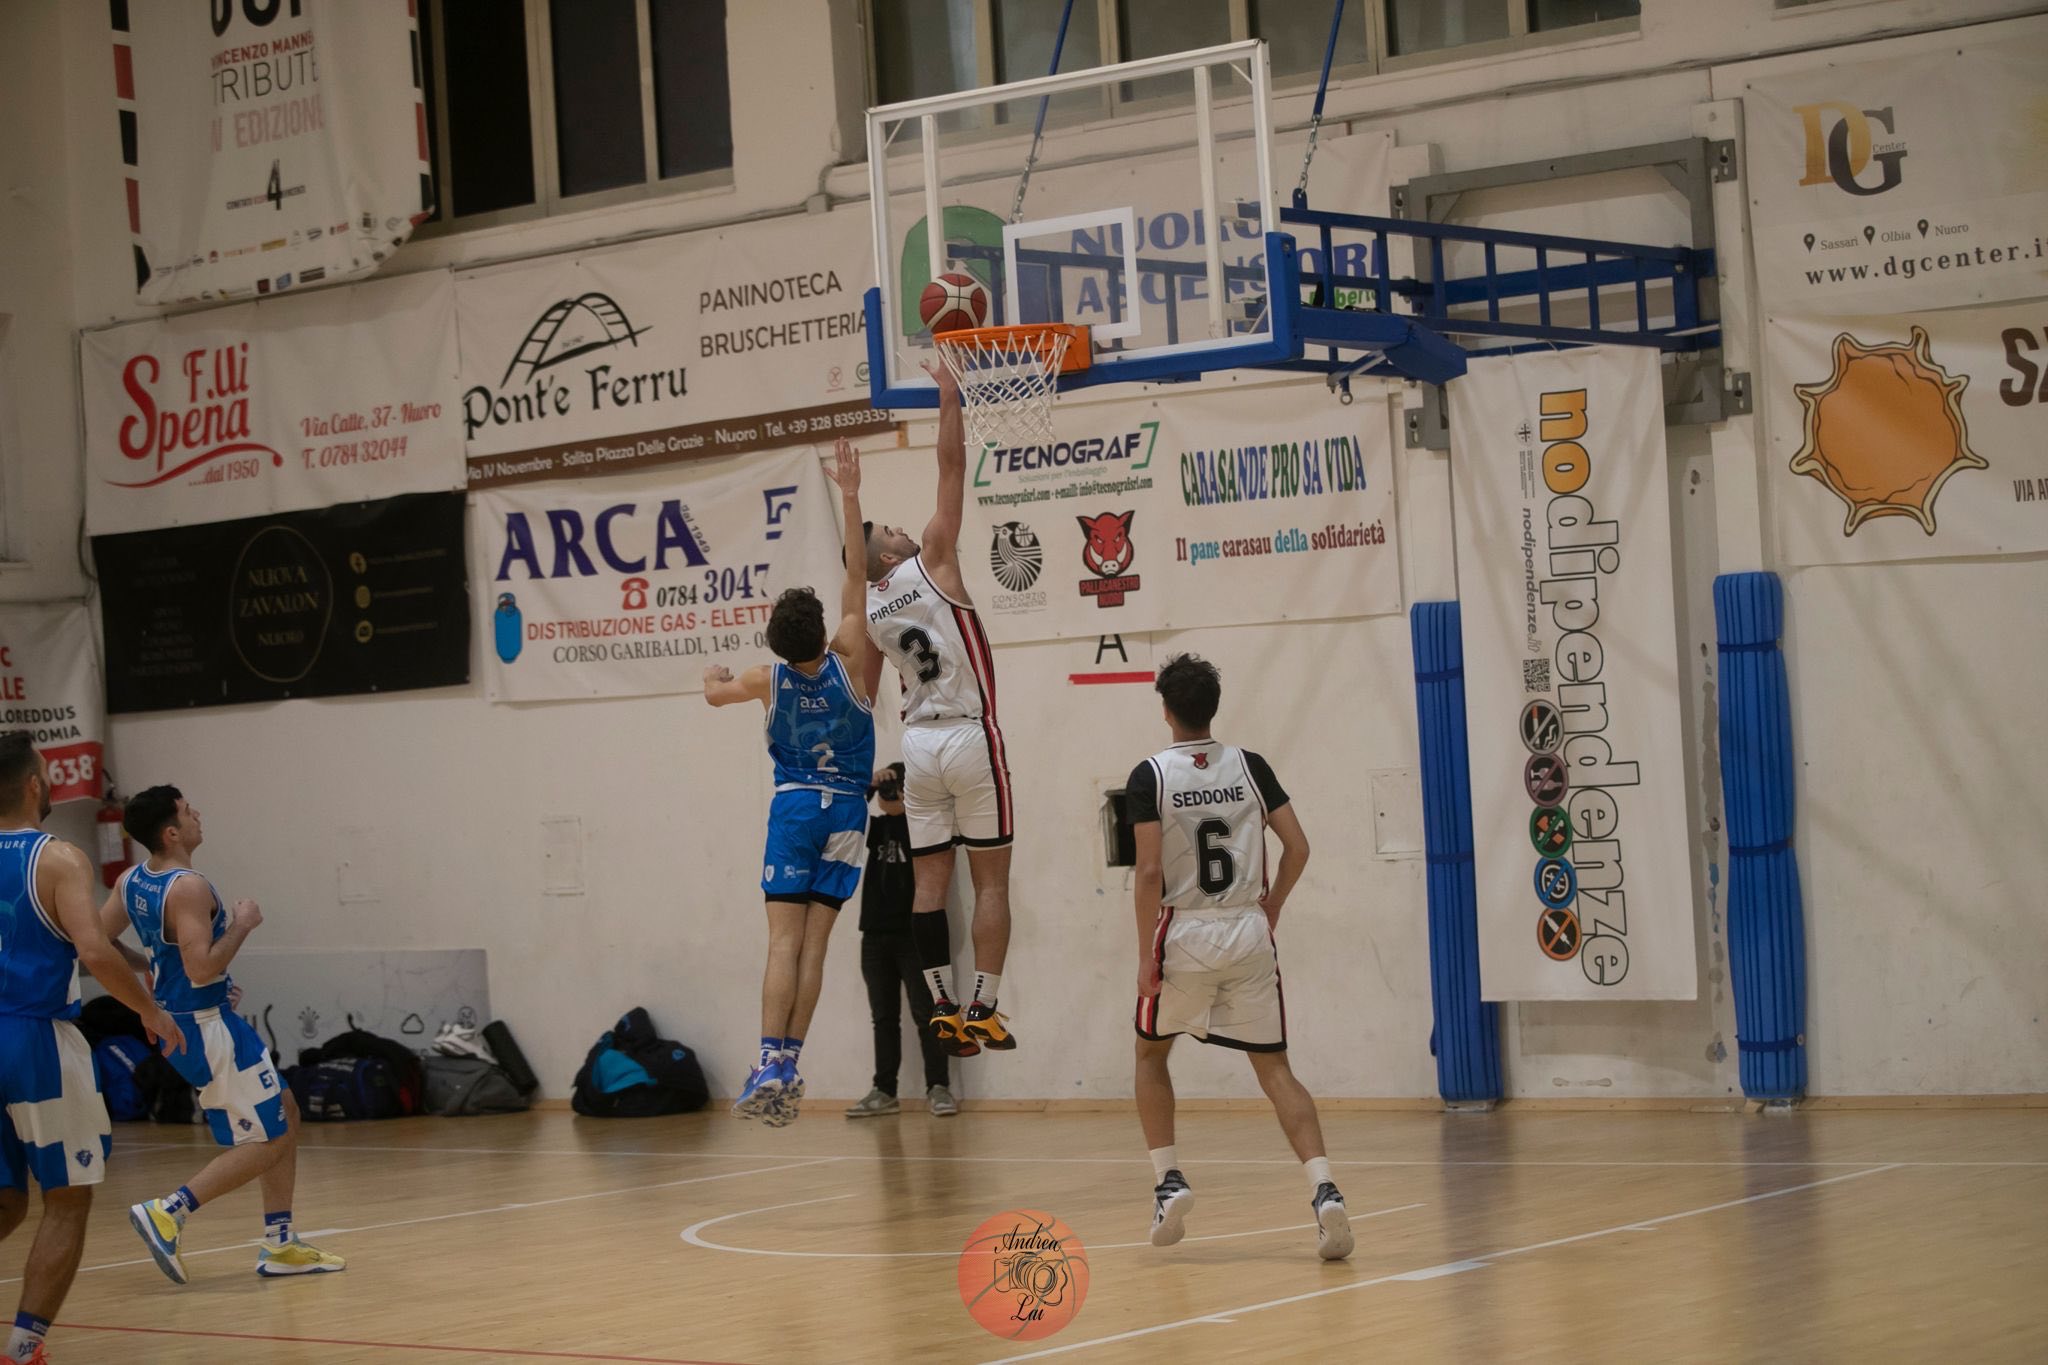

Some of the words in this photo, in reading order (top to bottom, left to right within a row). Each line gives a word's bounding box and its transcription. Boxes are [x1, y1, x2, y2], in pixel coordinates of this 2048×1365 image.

[1872, 140, 1907, 154] Center
[1820, 236, 1859, 250] Sassari
[1881, 230, 1911, 243] Olbia
[1934, 223, 1969, 237] Nuoro
[1805, 238, 2048, 285] www.dgcenter.i
[700, 270, 842, 315] PANINOTECA
[119, 355, 250, 472] Spena
[400, 402, 441, 424] Nuoro
[462, 375, 571, 440] Pont'e
[585, 364, 688, 411] Ferru
[302, 448, 315, 469] T.
[319, 440, 358, 468] 0784
[361, 436, 408, 462] 32044
[484, 463, 495, 478] IV
[497, 457, 553, 476] Novembre
[562, 451, 593, 467] Salita
[596, 447, 635, 463] Piazza
[637, 439, 666, 456] Delle
[667, 433, 704, 452] Grazie
[715, 427, 757, 445] Nuoro
[764, 421, 786, 437] Tel.
[788, 419, 808, 434] +39
[810, 415, 832, 431] 328
[993, 433, 1141, 473] TECNOGRAF
[227, 459, 260, 482] 1950
[1181, 446, 1268, 507] CARASANDE
[1271, 442, 1299, 498] PRO
[1303, 440, 1323, 496] SA
[1325, 435, 1366, 493] VIDA
[2013, 479, 2035, 501] VIA
[495, 499, 711, 581] ARCA
[1176, 537, 1188, 561] Il
[1190, 540, 1220, 566] pane
[1222, 537, 1272, 558] carasau
[1275, 527, 1309, 554] della
[1311, 519, 1386, 550] solidarietà
[657, 584, 698, 608] 0784
[868, 588, 922, 625] PIREDDA
[527, 616, 654, 641] DISTRIBUZIONE
[661, 612, 696, 633] GAS
[711, 604, 774, 627] ELETT
[553, 643, 607, 664] CORSO
[611, 637, 708, 661] GARIBALDI,
[713, 633, 740, 655] 149
[899, 626, 943, 684] 3
[1540, 388, 1642, 986] nodipendenze
[1172, 786, 1245, 809] SEDDONE
[1195, 817, 1236, 896] 6
